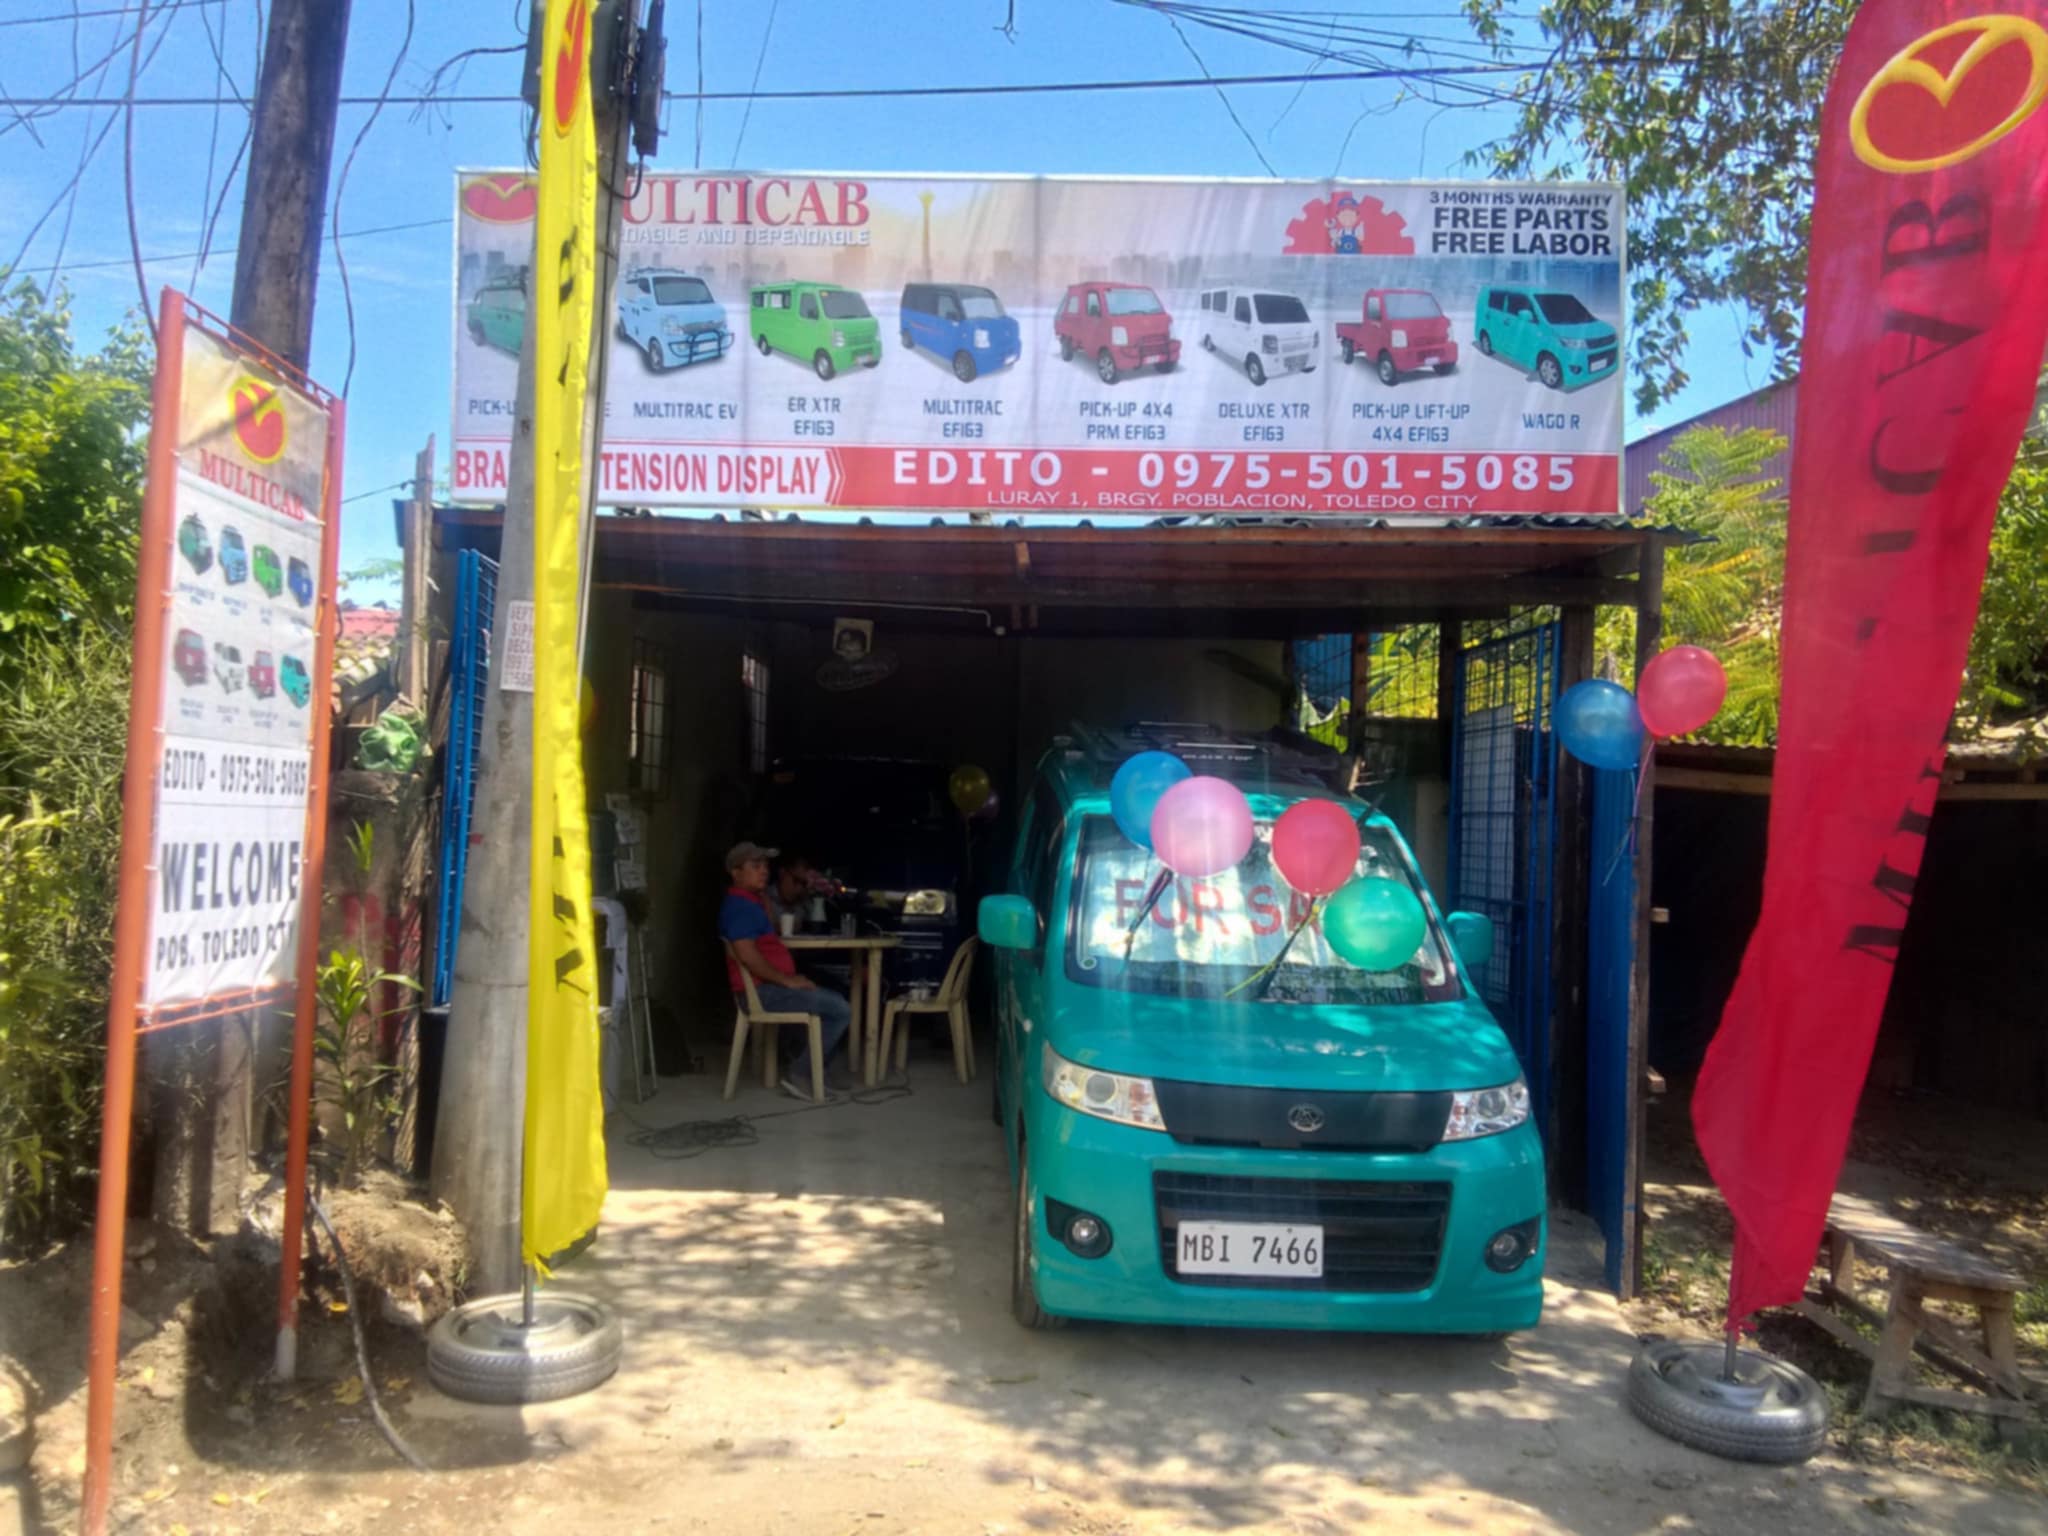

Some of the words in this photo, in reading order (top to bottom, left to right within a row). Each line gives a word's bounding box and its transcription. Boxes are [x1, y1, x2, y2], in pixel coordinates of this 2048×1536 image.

[622, 178, 870, 227] ULTICAB
[1429, 190, 1441, 204] 3
[1443, 190, 1516, 205] MONTHS
[1434, 207, 1508, 230] FREE
[1515, 208, 1609, 231] PARTS
[696, 228, 737, 246] AND
[744, 228, 871, 247] DEPENDABLE
[1432, 231, 1506, 254] FREE
[1513, 232, 1612, 256] LABOR
[633, 401, 713, 419] MULTITRAC
[718, 403, 738, 420] EV
[787, 396, 806, 413] ER
[812, 397, 841, 413] XTR
[923, 399, 1003, 416] MULTITRAC
[1079, 401, 1137, 418] PICK-UP
[1142, 402, 1173, 418] 4X4
[1218, 403, 1275, 419] DELUXE
[1281, 403, 1310, 419] XTR
[1352, 403, 1410, 419] PICK-UP
[1415, 403, 1470, 419] LIFT-UP
[1570, 414, 1580, 430] R
[1086, 424, 1120, 440] PRM
[1372, 426, 1402, 442] 4X4
[455, 449, 507, 489] BRA
[600, 451, 707, 492] TENSION
[718, 455, 821, 495] DISPLAY
[893, 450, 1062, 487] EDITO
[1138, 453, 1575, 492] 0975-501-5085
[987, 490, 1060, 505] LURAY
[1097, 492, 1163, 506] BRGY.
[1172, 493, 1314, 509] POBLACION,
[1322, 494, 1416, 509] TOLEDO
[1424, 495, 1478, 508] CITY
[163, 748, 206, 791] EDITO
[160, 840, 300, 913] WELCOME
[1113, 878, 1230, 936] FOR
[202, 924, 259, 965] TOLEDO
[1182, 1233, 1230, 1262] MBI
[1252, 1236, 1319, 1265] 7466
